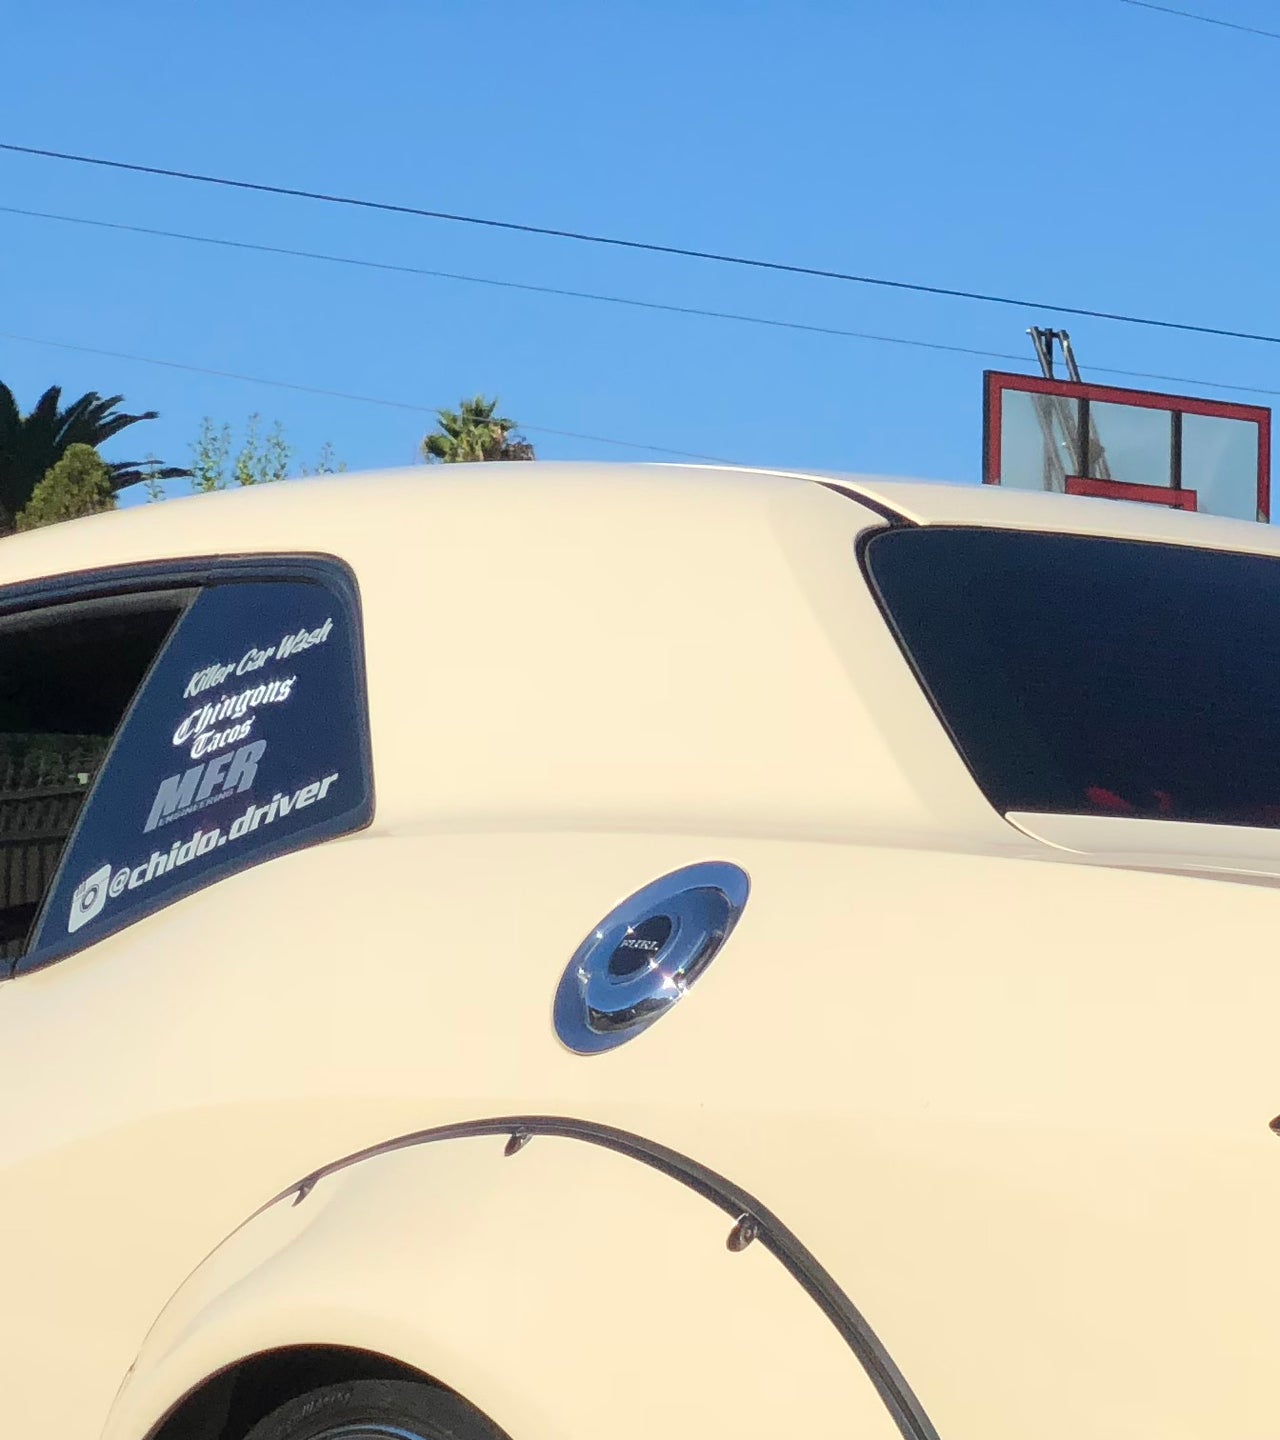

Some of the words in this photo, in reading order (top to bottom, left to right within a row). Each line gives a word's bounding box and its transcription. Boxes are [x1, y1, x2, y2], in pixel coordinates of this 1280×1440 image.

[183, 663, 236, 698] Killer
[235, 646, 276, 676] Car
[276, 617, 333, 659] Wash
[172, 675, 296, 745] Chingons
[190, 716, 255, 759] Tacos
[143, 739, 267, 834] MFR
[108, 773, 339, 898] @chido.driver
